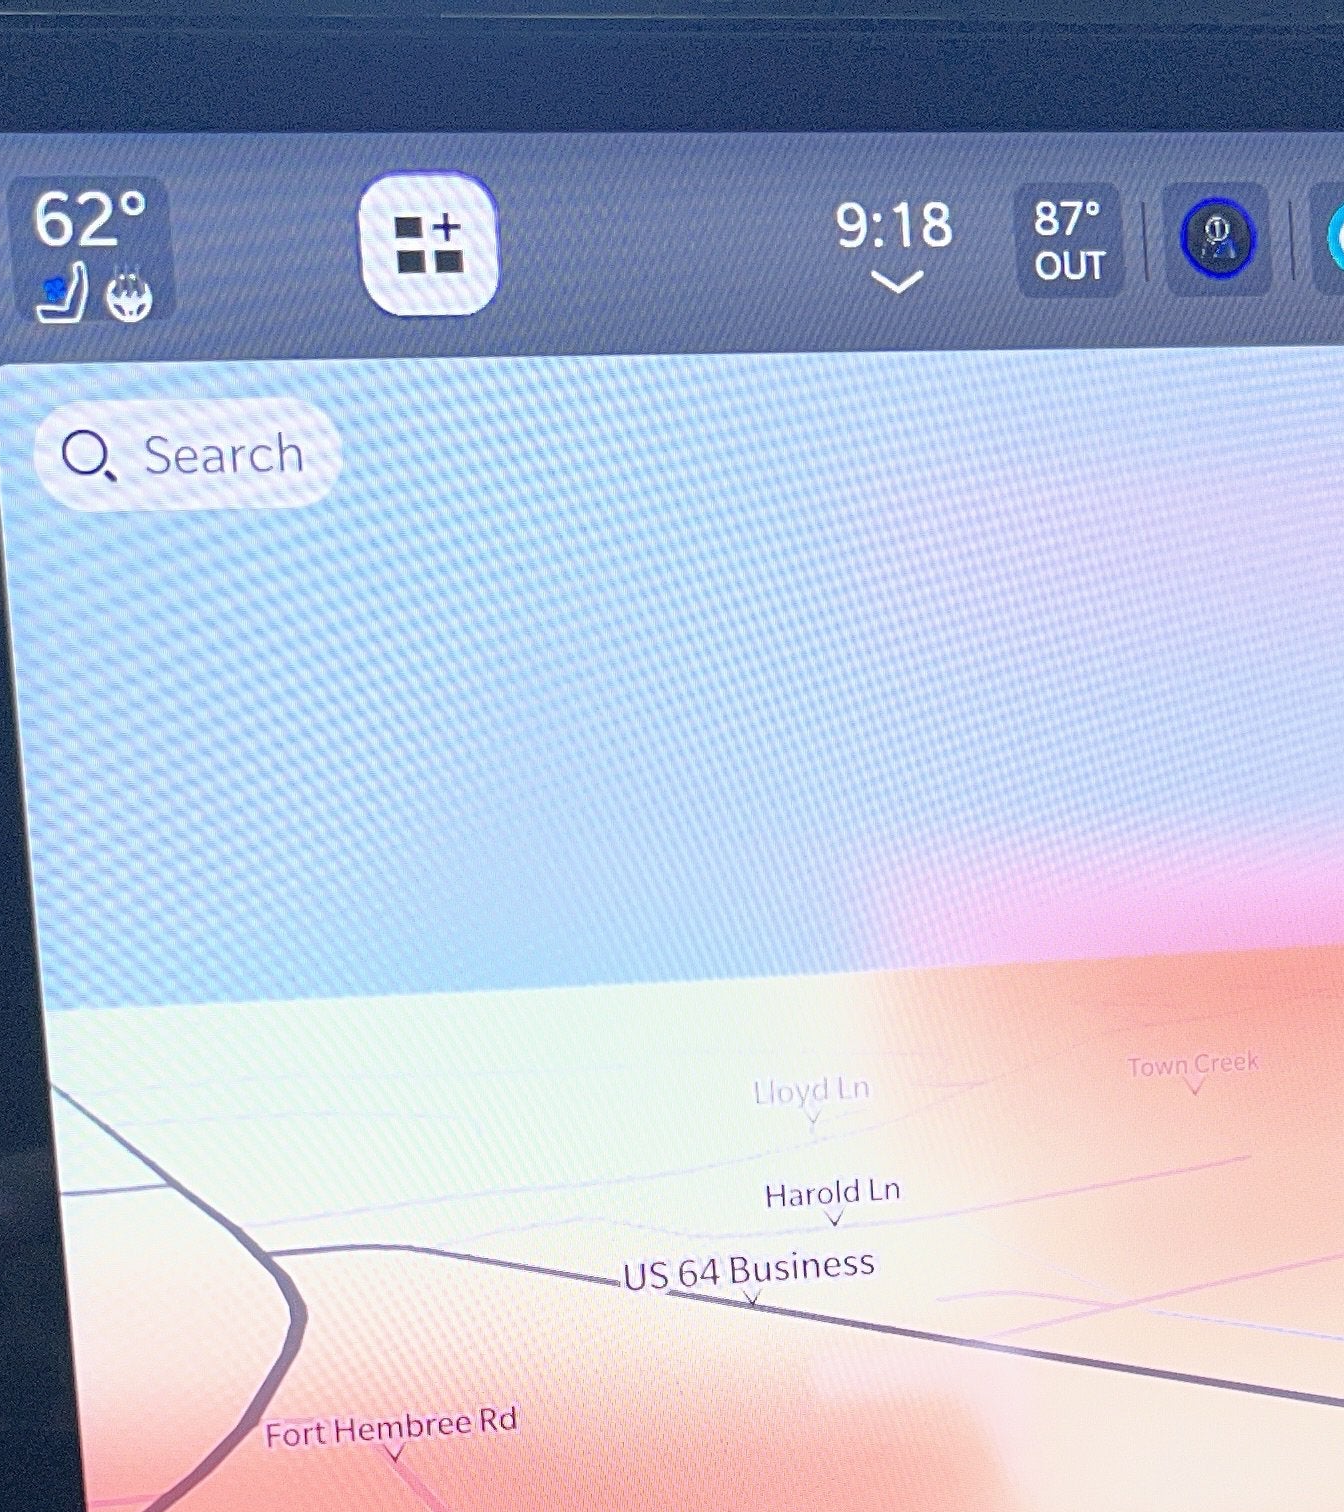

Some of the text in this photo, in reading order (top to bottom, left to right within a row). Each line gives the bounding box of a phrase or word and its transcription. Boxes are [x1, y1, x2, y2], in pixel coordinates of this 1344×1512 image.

[835, 200, 954, 250] 9:18
[1035, 250, 1107, 282] OUT
[144, 432, 305, 476] Search
[1127, 1049, 1259, 1077] Town Creek
[754, 1075, 870, 1108] Lloyd Ln
[764, 1176, 901, 1209] Harold Ln
[622, 1251, 876, 1293] US 64 Business
[265, 1405, 518, 1449] Fort Hembree Rd
